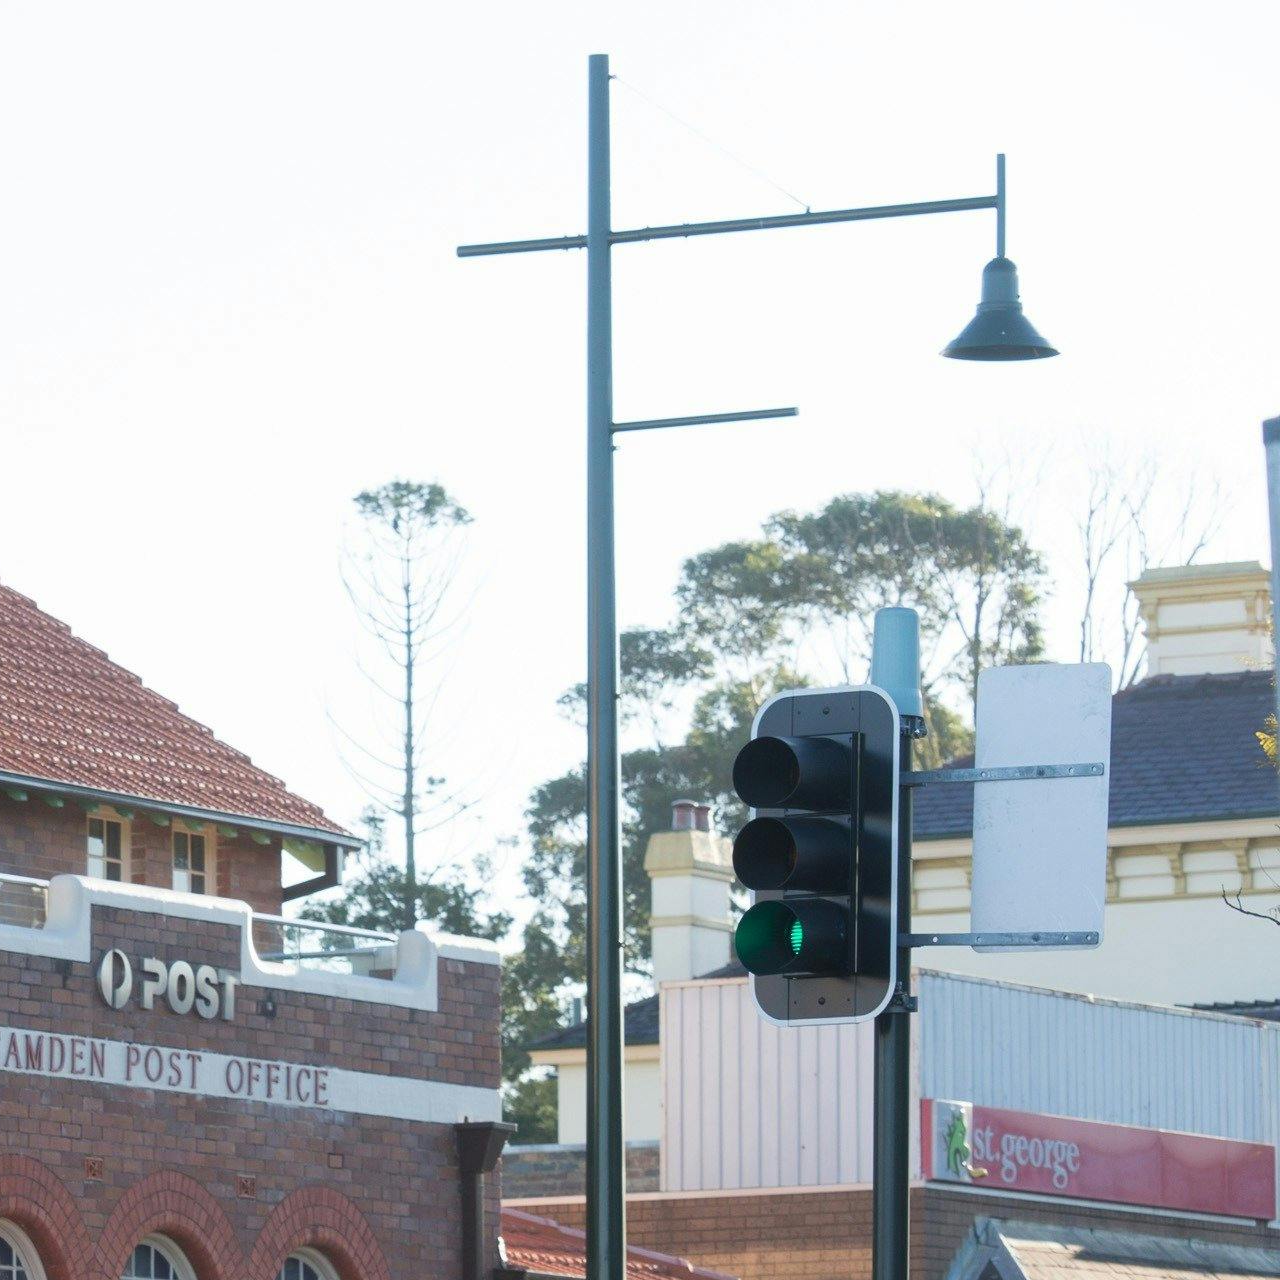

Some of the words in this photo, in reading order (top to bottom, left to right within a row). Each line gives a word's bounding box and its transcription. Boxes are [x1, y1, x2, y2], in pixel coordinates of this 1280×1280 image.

[141, 957, 240, 1021] POST
[125, 1043, 202, 1089] POST
[225, 1059, 329, 1105] OFFICE
[973, 1124, 1080, 1189] st.george
